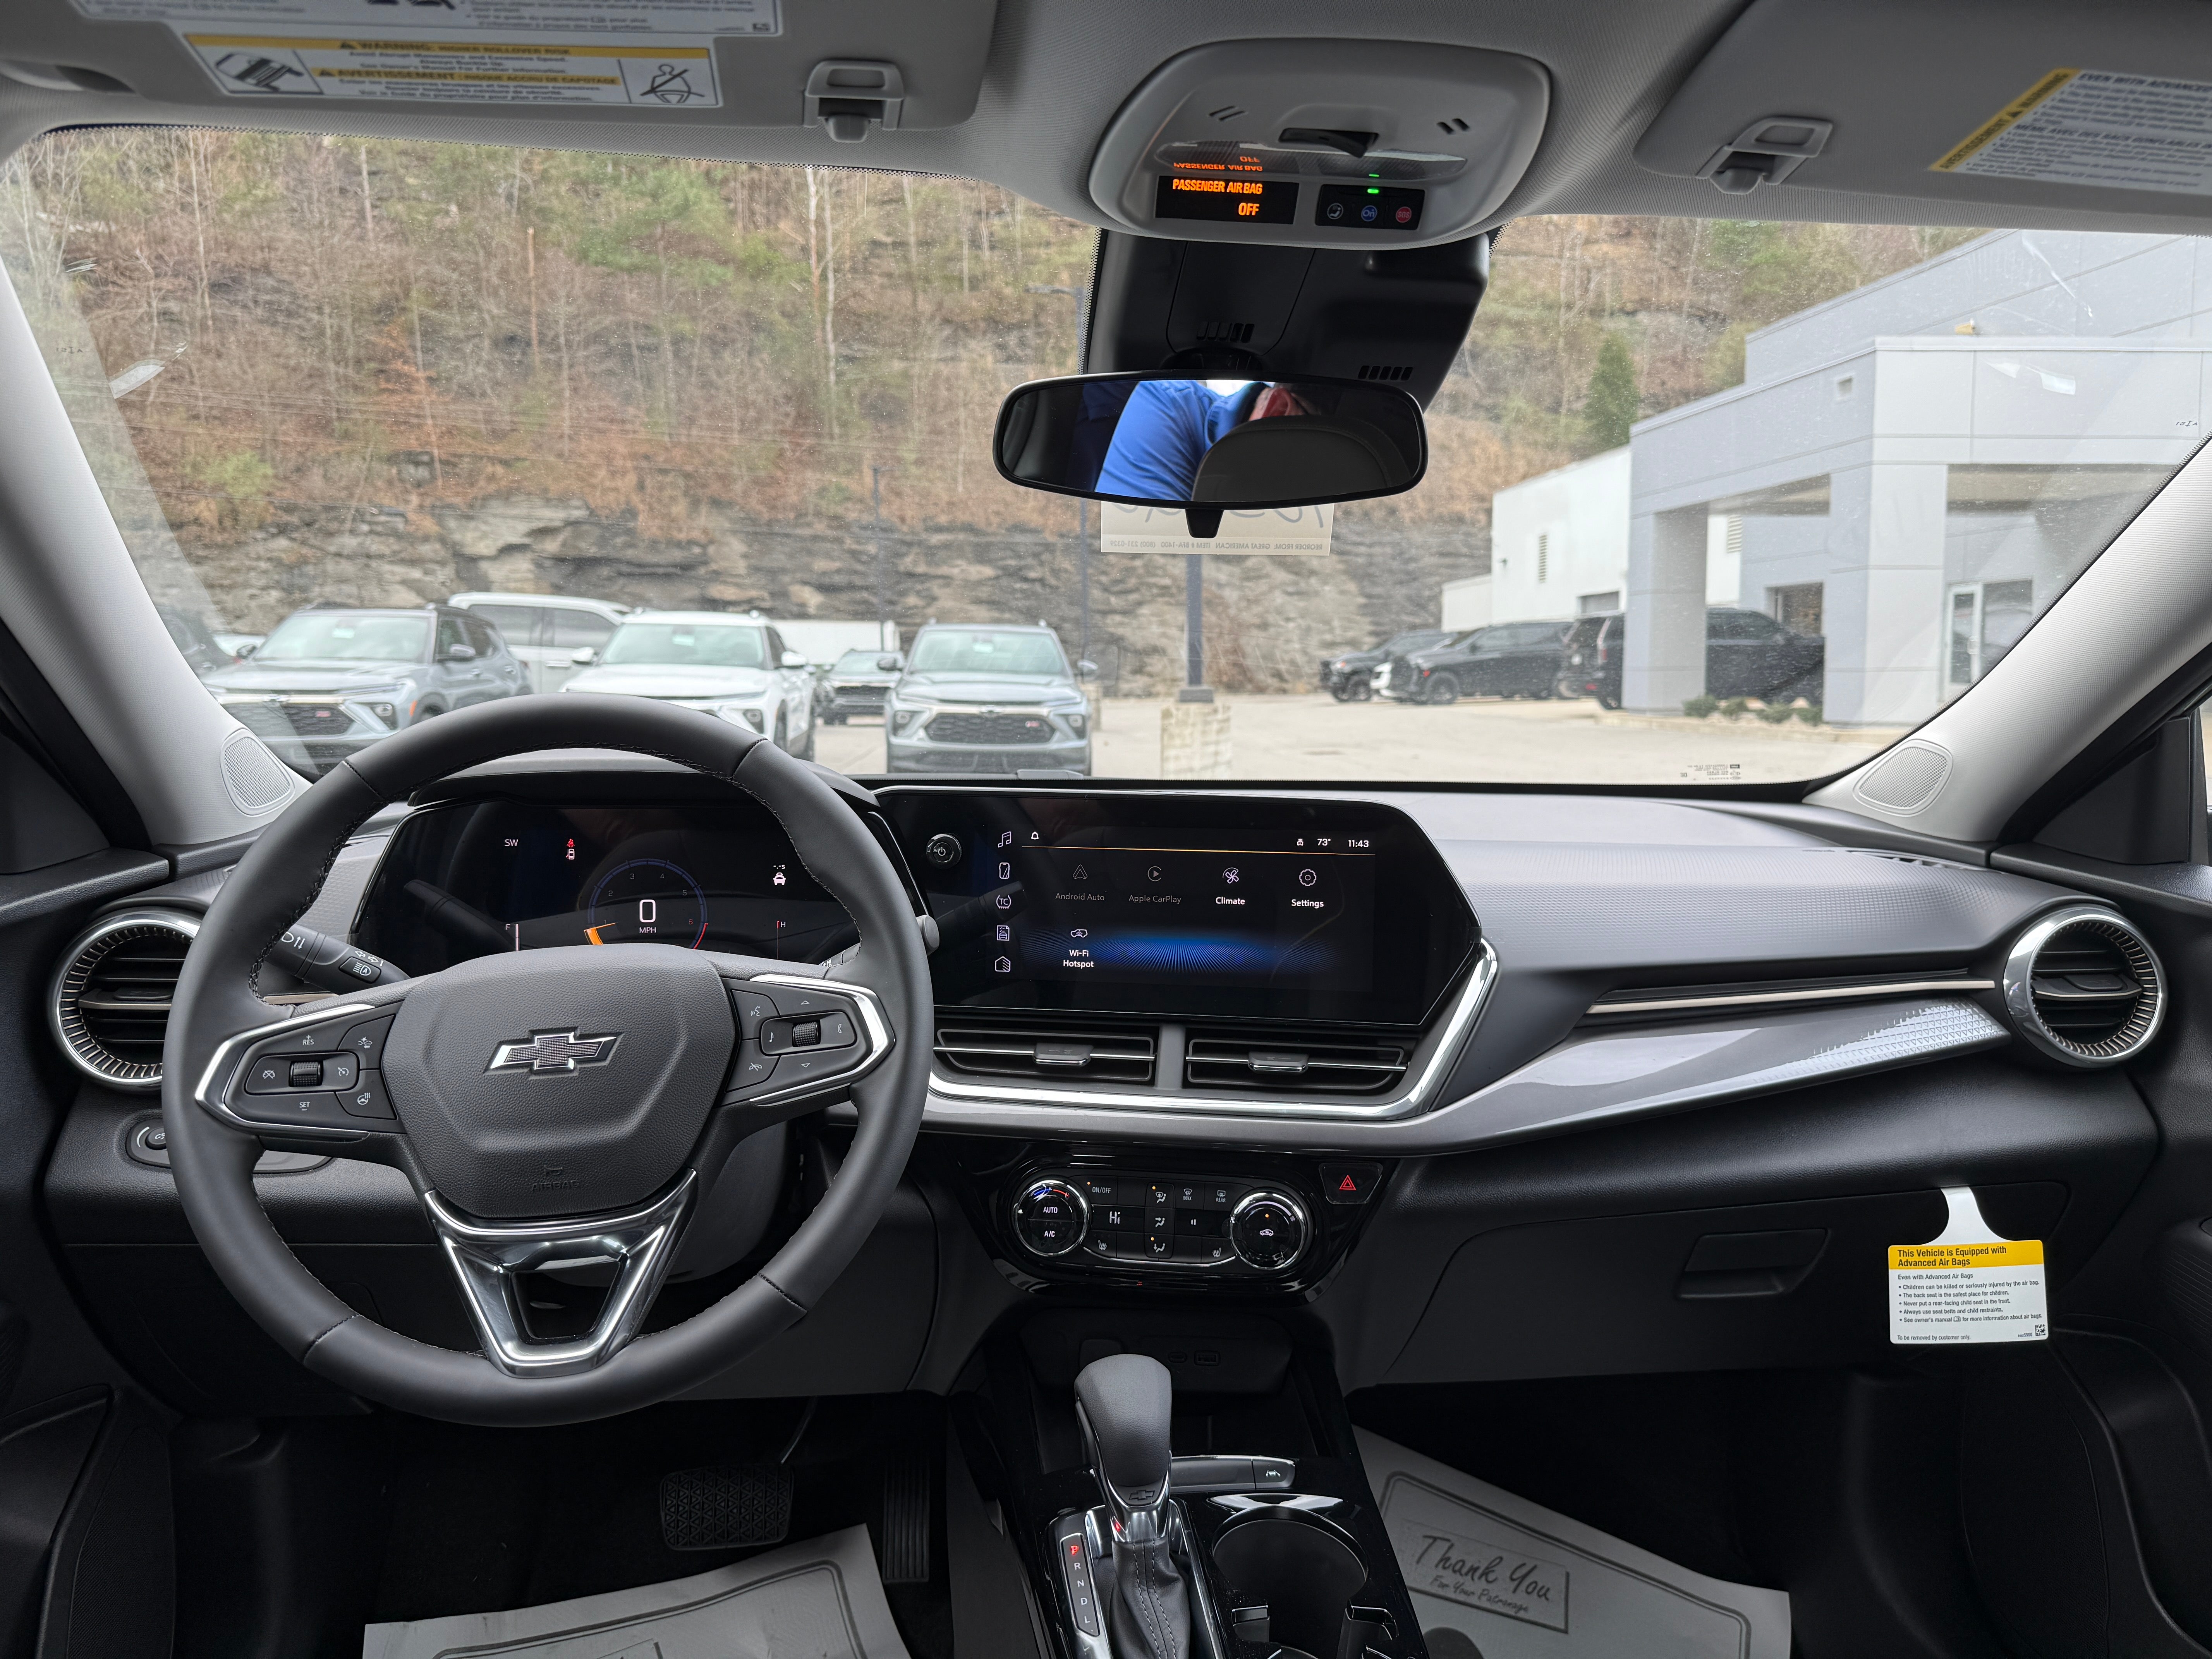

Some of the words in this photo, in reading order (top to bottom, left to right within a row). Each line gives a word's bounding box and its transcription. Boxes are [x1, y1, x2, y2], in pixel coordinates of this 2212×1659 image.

[1173, 179, 1225, 192] PASSENGER
[1238, 203, 1259, 216] OFF
[1129, 895, 1150, 903] Apple
[1153, 896, 1181, 904] CarPlay
[1291, 899, 1324, 908] Settings
[640, 900, 656, 922] 0
[1063, 960, 1094, 969] Hotspot
[1110, 1212, 1120, 1224] Hi
[1916, 1249, 1944, 1257] Vehicle
[1955, 1247, 1989, 1257] Equipped
[1898, 1258, 1936, 1267] Advanced
[1938, 1258, 1949, 1266] Air
[1951, 1258, 1970, 1267] Bags
[1071, 1545, 1079, 1555] P
[1416, 1534, 1503, 1583] Thank
[1510, 1562, 1550, 1601] You
